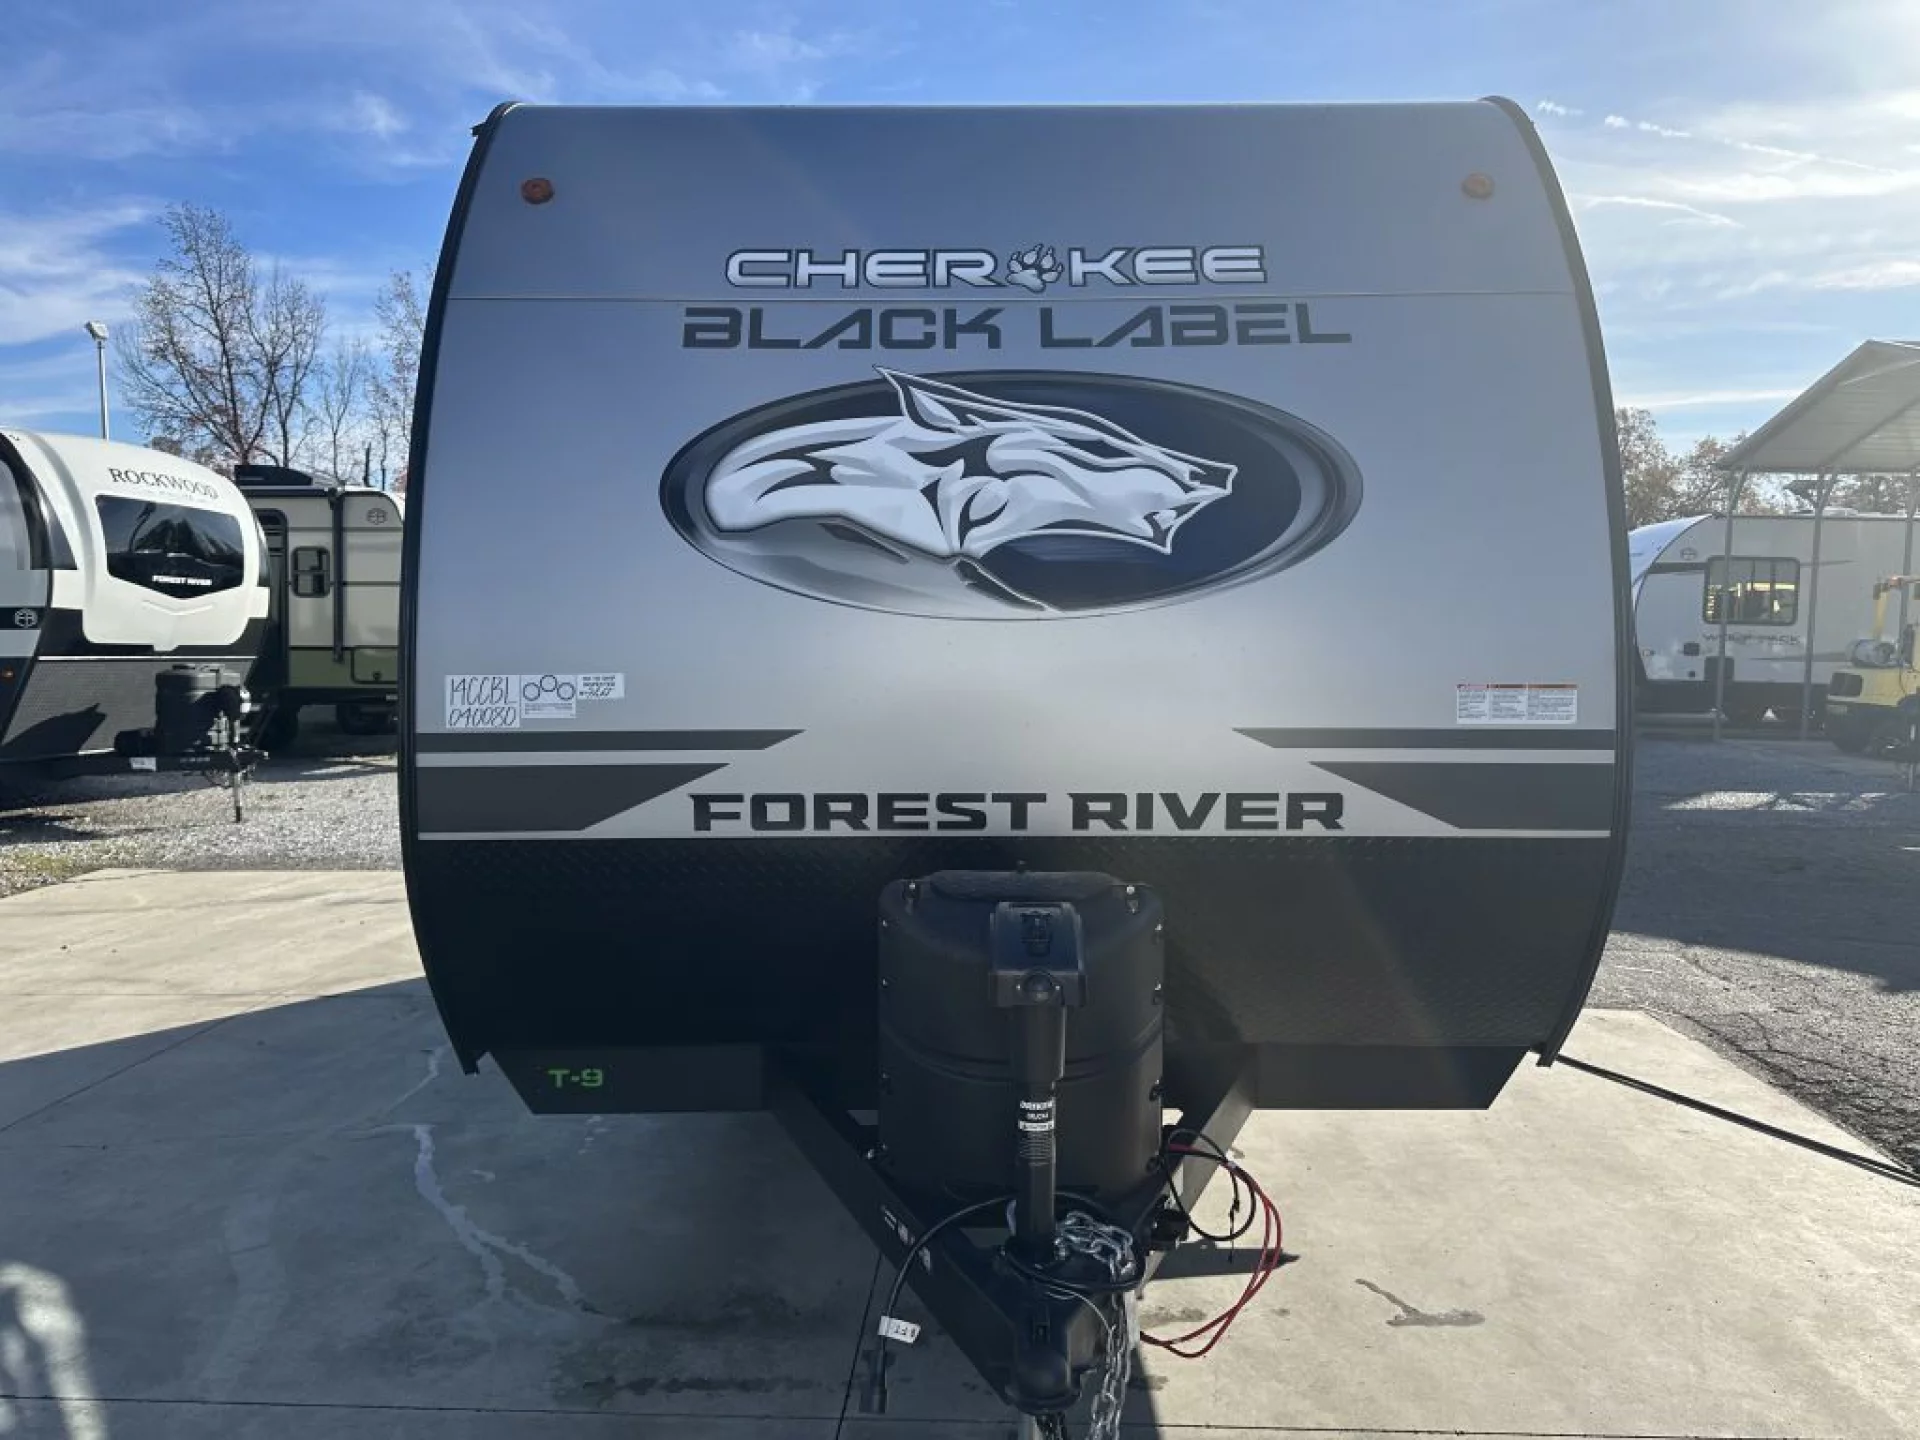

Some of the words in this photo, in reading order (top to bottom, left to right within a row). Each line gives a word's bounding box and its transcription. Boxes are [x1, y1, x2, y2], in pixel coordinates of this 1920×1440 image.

[682, 307, 1005, 350] BLACK
[1040, 303, 1352, 348] LABEL
[108, 467, 219, 499] ROCKWOOD
[688, 793, 1047, 831] FOREST
[1067, 793, 1344, 831] RIVER
[547, 1068, 603, 1088] T-9
